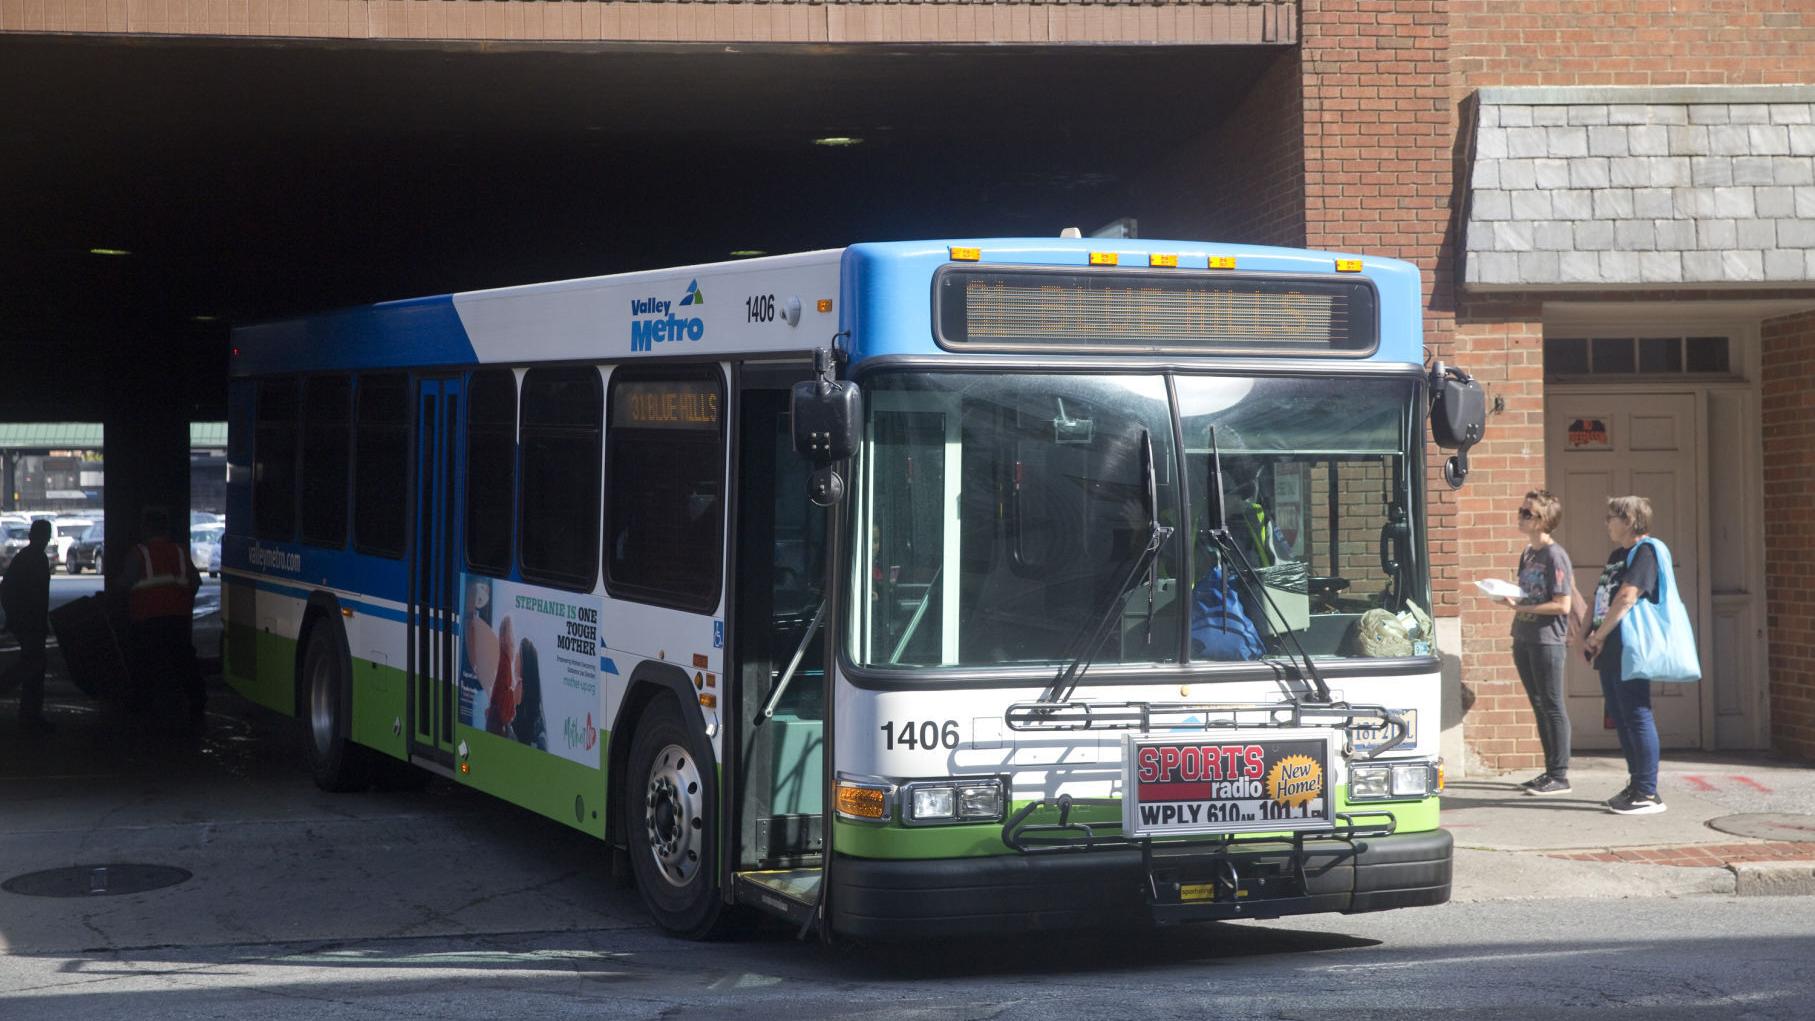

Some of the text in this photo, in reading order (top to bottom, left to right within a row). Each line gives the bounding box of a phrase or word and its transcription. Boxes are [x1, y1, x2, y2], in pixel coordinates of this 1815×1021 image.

[631, 297, 671, 316] Valley
[746, 294, 775, 322] 1406
[630, 313, 704, 352] Metro
[680, 393, 717, 422] HILLS
[515, 595, 597, 623] STEPHANIE IS ONE
[566, 621, 597, 640] TOUGH
[557, 635, 596, 656] MOTHER
[881, 720, 960, 750] 1406
[1138, 745, 1264, 783] SPORTS
[1281, 763, 1312, 780] New
[1211, 776, 1263, 799] radio
[1277, 774, 1321, 798] Home!
[1140, 804, 1202, 826] WPLY
